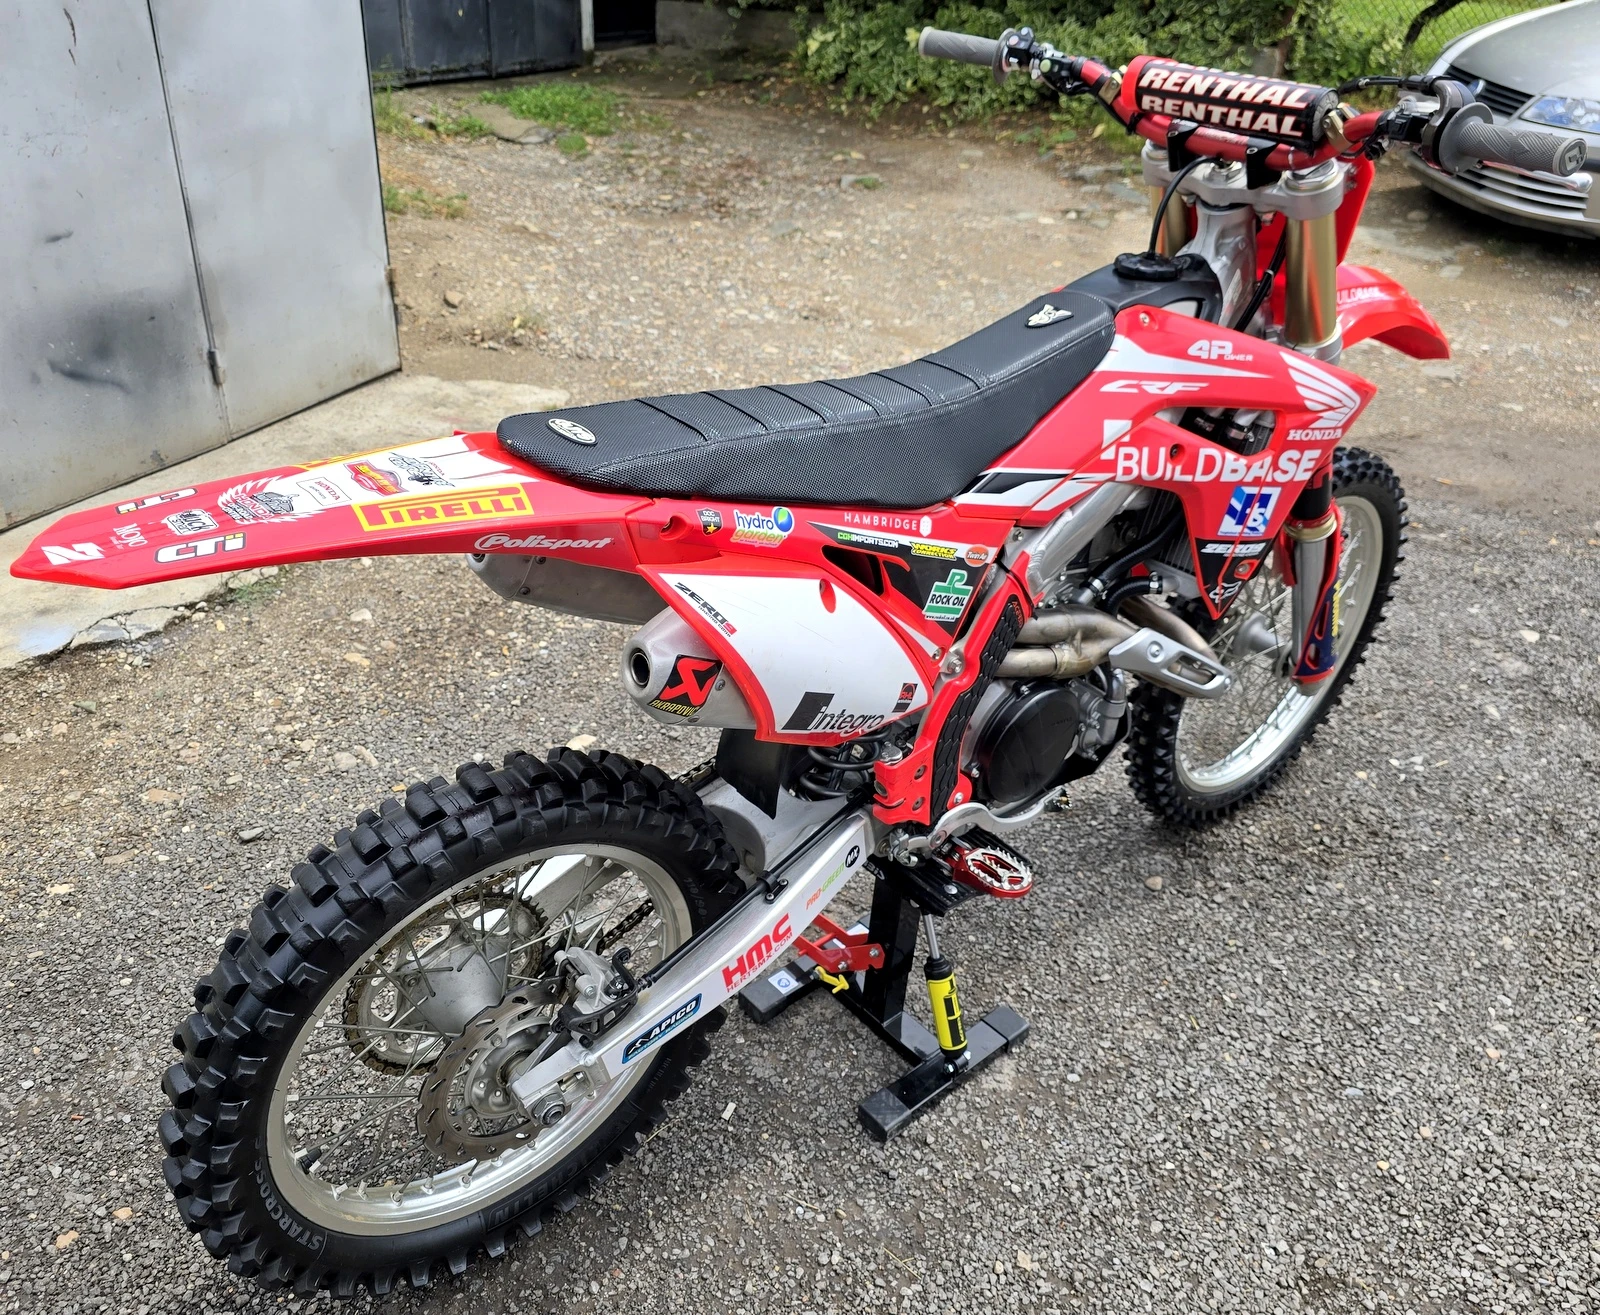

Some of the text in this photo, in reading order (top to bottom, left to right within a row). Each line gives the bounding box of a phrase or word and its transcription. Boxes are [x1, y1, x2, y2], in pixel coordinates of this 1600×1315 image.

[1138, 67, 1310, 109] RENTHAL
[1141, 94, 1304, 137] RENTHAL
[1100, 379, 1209, 394] CRF
[1287, 428, 1342, 441] HONDA
[360, 486, 527, 527] PIRELLI
[735, 511, 774, 530] hydro
[844, 512, 918, 531] HAMBRIDGE
[474, 533, 612, 551] Polisport
[733, 528, 783, 544] garden
[929, 593, 966, 607] ROCK OIL
[806, 705, 885, 735] integro
[722, 912, 793, 988] HMC
[650, 999, 698, 1038] APICO
